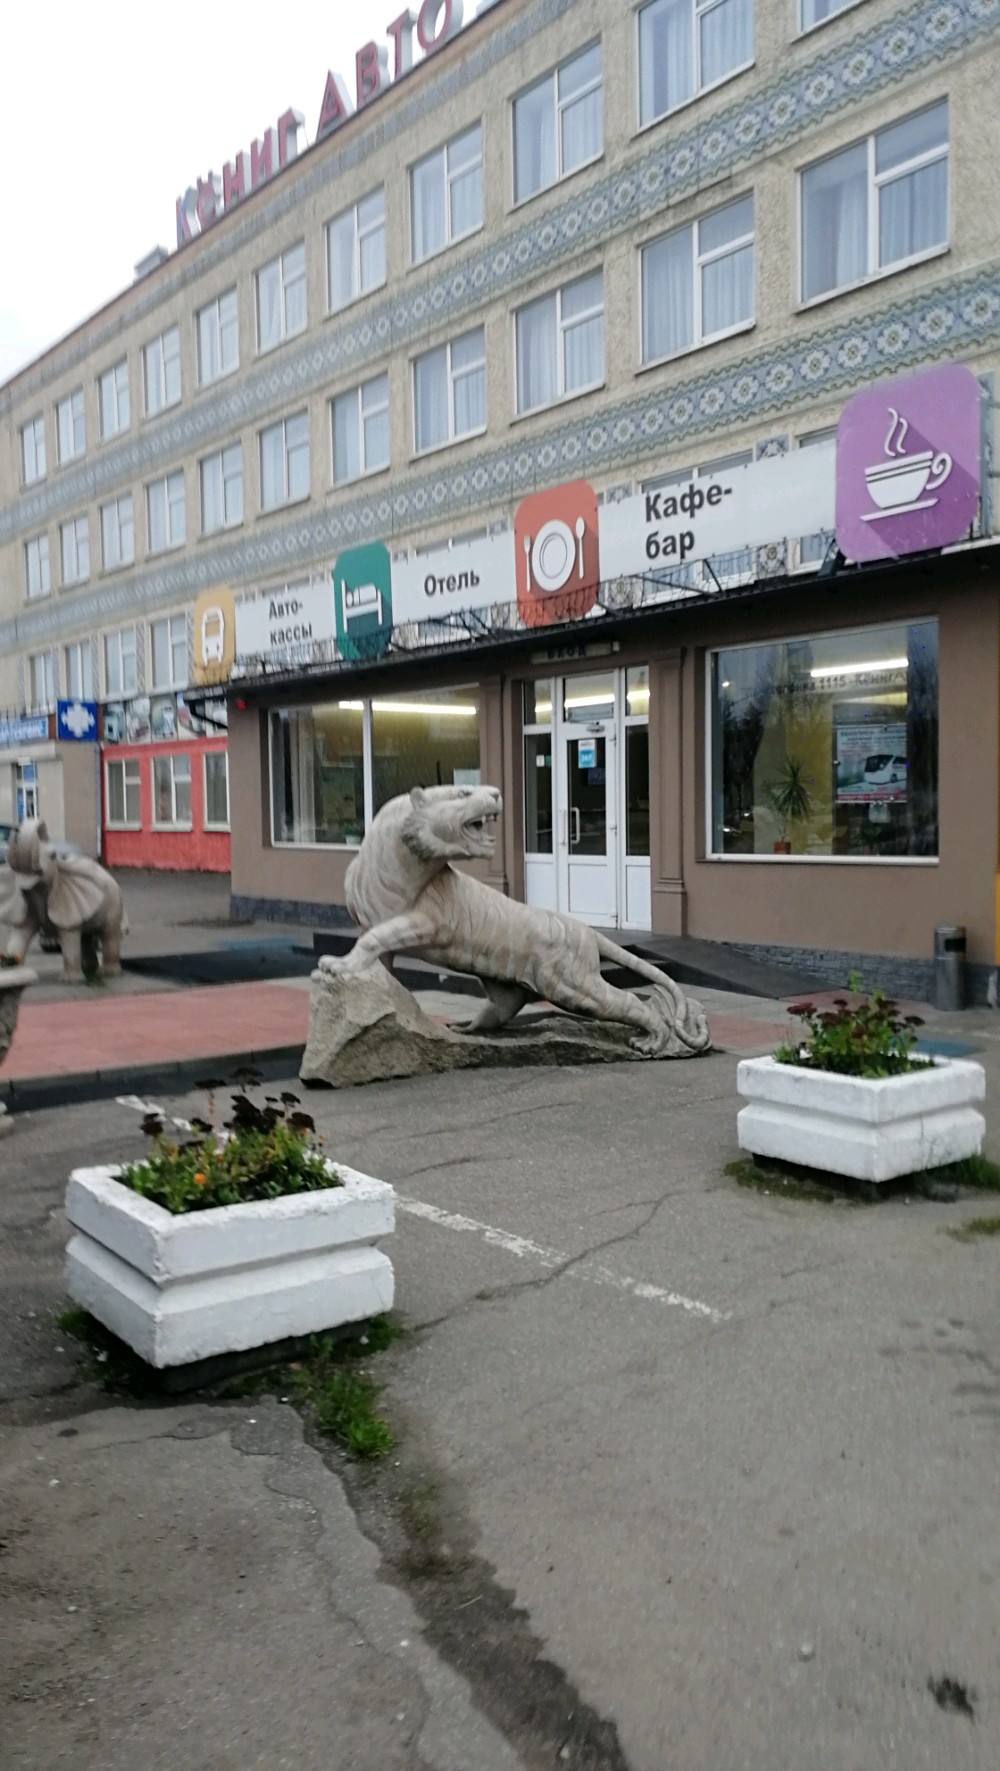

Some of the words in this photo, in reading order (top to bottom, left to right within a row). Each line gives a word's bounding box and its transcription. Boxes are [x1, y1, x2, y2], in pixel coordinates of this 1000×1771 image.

[645, 483, 732, 522] Кафе-
[645, 531, 695, 559] бар
[424, 570, 480, 597] Отель
[269, 599, 303, 620] Авто-
[270, 621, 312, 645] кассы
